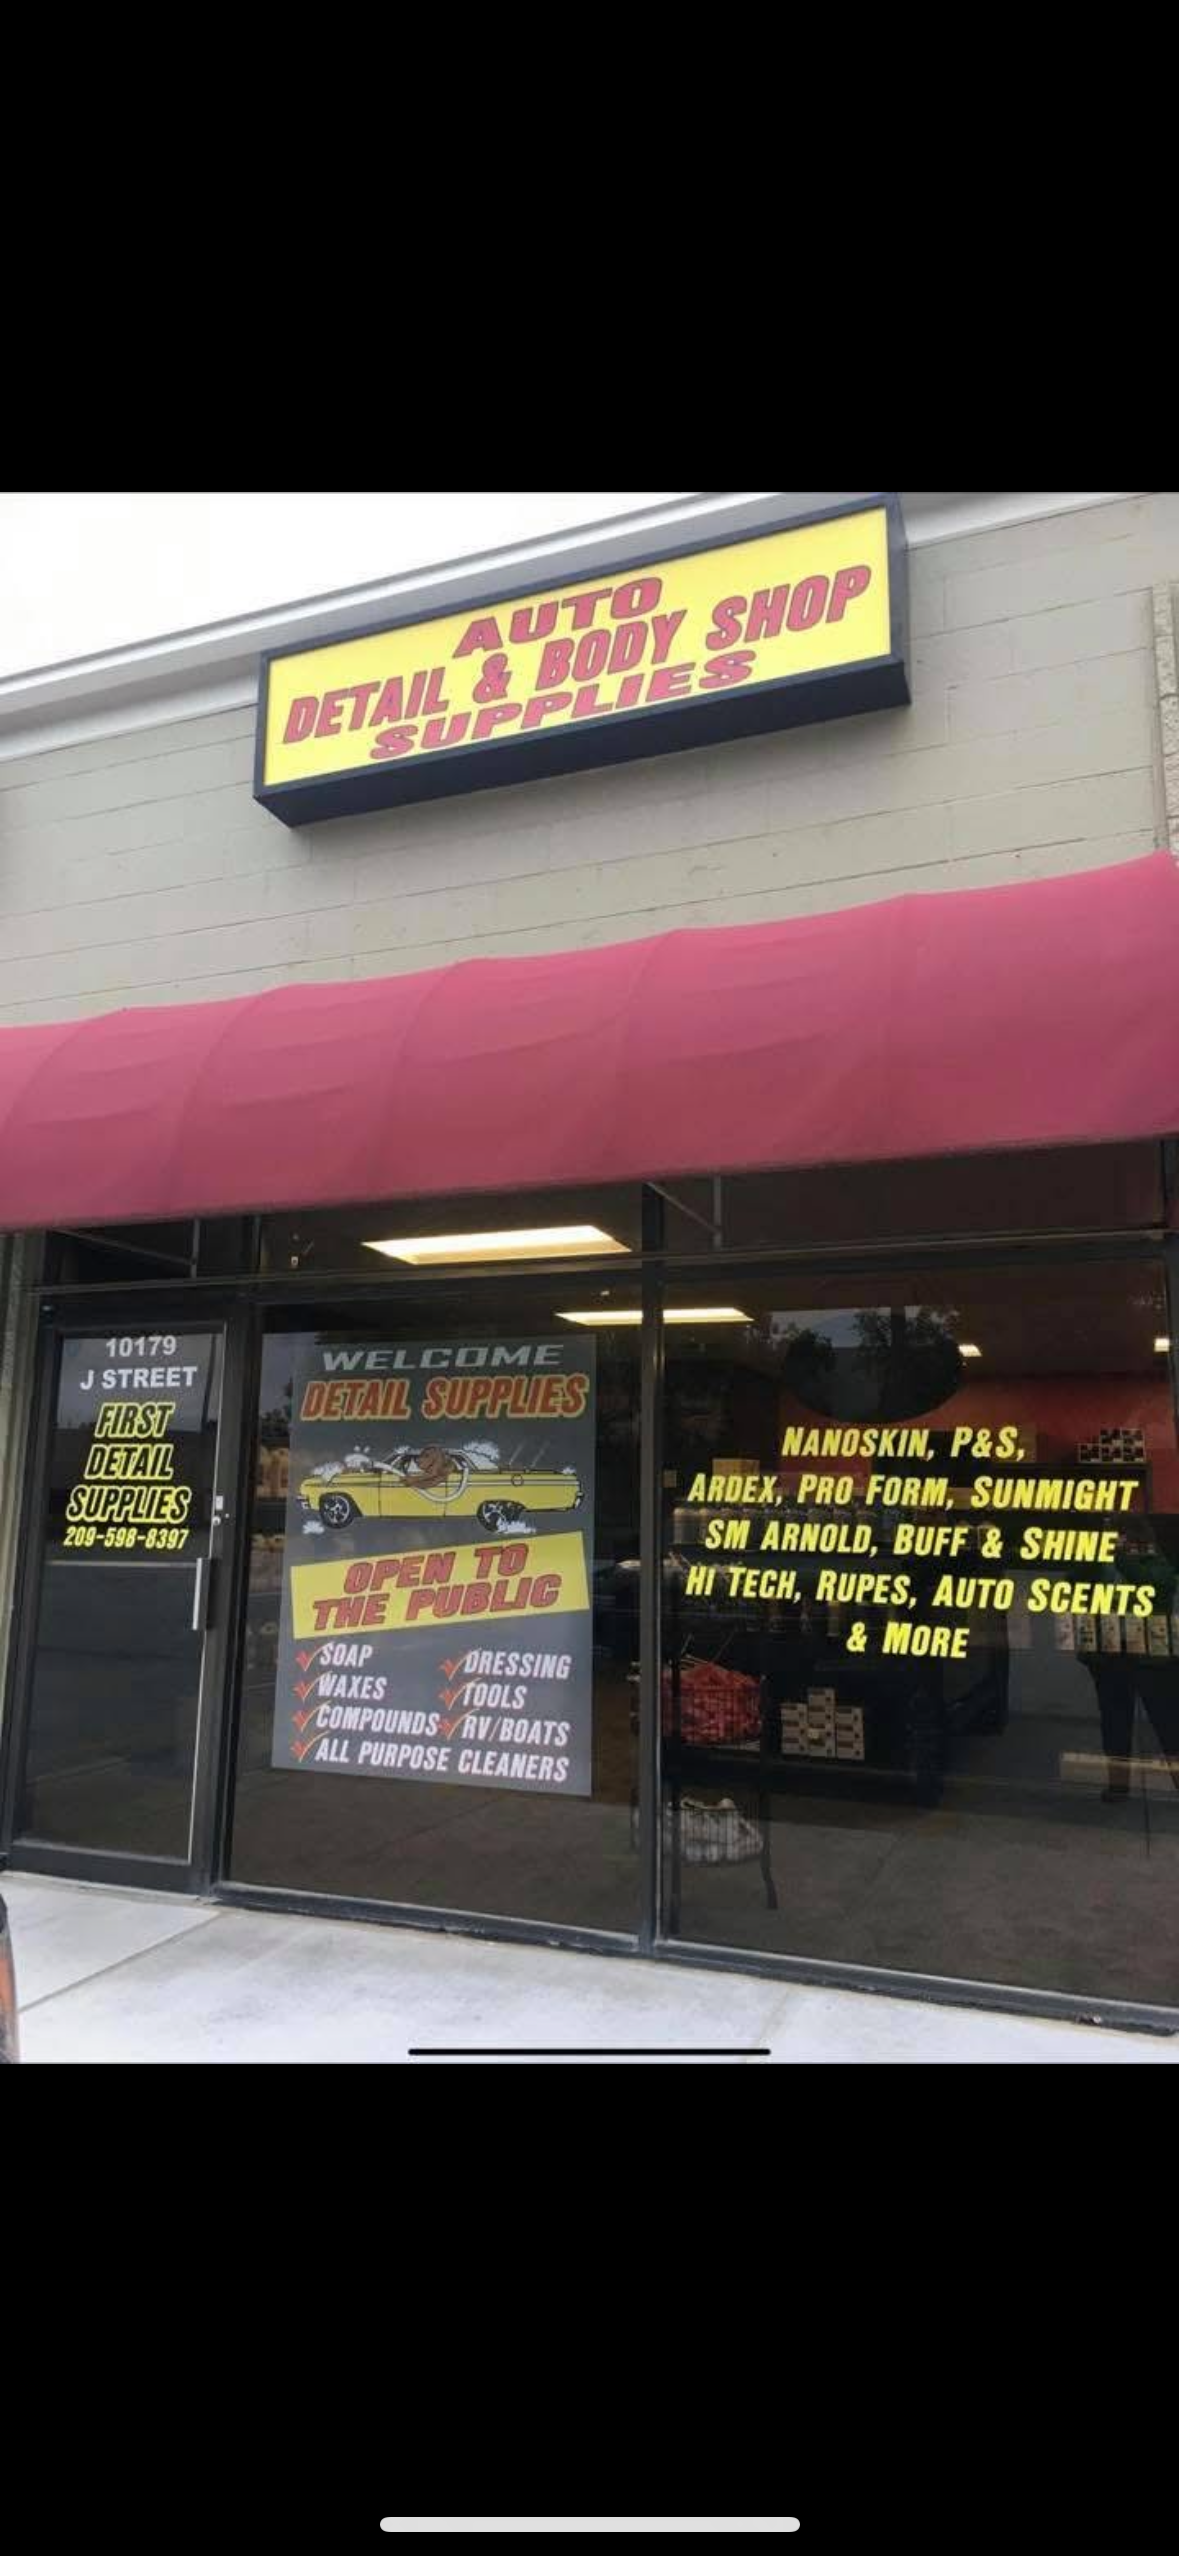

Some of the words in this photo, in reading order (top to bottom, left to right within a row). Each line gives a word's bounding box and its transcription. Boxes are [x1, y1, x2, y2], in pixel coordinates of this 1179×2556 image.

[453, 577, 663, 660] AUTO
[283, 667, 448, 745] DETAIL
[472, 653, 512, 705] &
[535, 610, 687, 691] BODY
[707, 565, 872, 650] SHOP
[370, 650, 756, 760] SUPPLIES
[106, 1336, 177, 1357] 10179
[322, 1344, 564, 1372] WELCOME
[80, 1370, 94, 1390] J
[102, 1366, 197, 1389] STREET
[301, 1379, 411, 1421] DETAIL
[423, 1372, 588, 1419] SUPPLIES
[95, 1402, 175, 1438] FIRST
[782, 1426, 935, 1460] NANOSKIN,
[950, 1426, 1026, 1460] P&S,
[85, 1444, 174, 1480] DETAIL
[66, 1485, 191, 1523] SUPPLIES
[688, 1473, 782, 1506] ARDEX,
[797, 1474, 853, 1505] PRO
[866, 1475, 954, 1509] FORM,
[971, 1476, 1139, 1512] SUNMIGHT
[63, 1527, 189, 1549] 209-598-8397
[705, 1520, 750, 1550] SM
[761, 1524, 878, 1558] ARNOLD,
[894, 1525, 967, 1558] BUFF
[981, 1529, 1003, 1558] &
[1020, 1527, 1119, 1563] SHINE
[344, 1550, 456, 1594] OPEN
[474, 1543, 530, 1577] TO
[312, 1594, 389, 1632] THE
[405, 1573, 563, 1621] PUBLIC
[686, 1566, 714, 1596] HI
[728, 1568, 801, 1602] TECH,
[817, 1574, 917, 1608] RUPES,
[933, 1575, 1014, 1610] AUTO
[1028, 1579, 1156, 1617] SCENTS
[320, 1642, 372, 1668] SOAP
[846, 1623, 867, 1652] &
[883, 1624, 969, 1658] MORE
[465, 1648, 572, 1680] DRESSING
[317, 1674, 388, 1700] WAXES
[463, 1681, 526, 1710] TOOLS
[316, 1704, 440, 1736] COMPOUNDS
[462, 1715, 571, 1747] RV/BOATS
[315, 1741, 350, 1764] ALL
[358, 1743, 451, 1772] PURPOSE
[458, 1751, 569, 1782] CLEANERS
